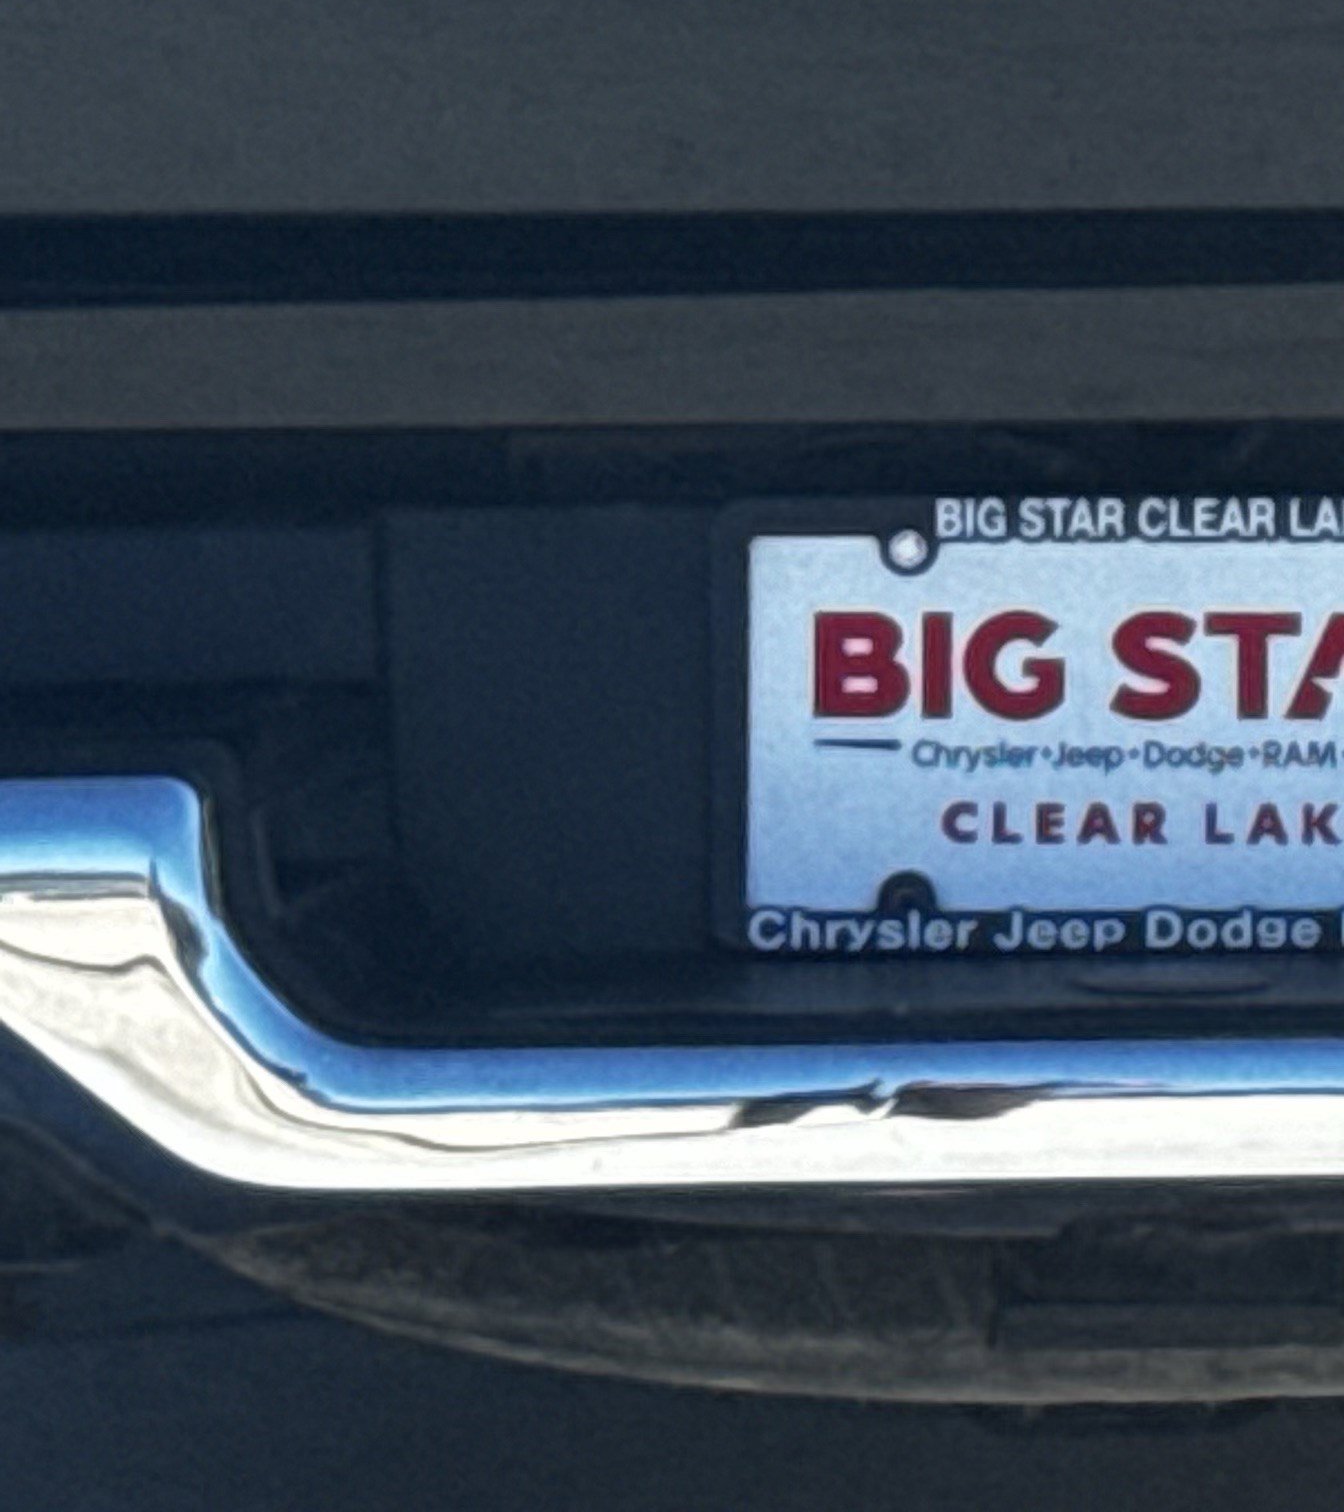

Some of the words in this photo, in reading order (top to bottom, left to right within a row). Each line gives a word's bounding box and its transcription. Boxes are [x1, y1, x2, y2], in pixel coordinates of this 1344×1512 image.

[935, 496, 1006, 538] BIG
[1018, 496, 1126, 538] STAR
[1138, 496, 1276, 538] CLEAR
[813, 610, 1066, 721] BIG
[941, 801, 1168, 846] CLEAR
[747, 908, 978, 953] Chrysler
[993, 908, 1126, 953] Jeep
[1144, 908, 1322, 950] Dodge
